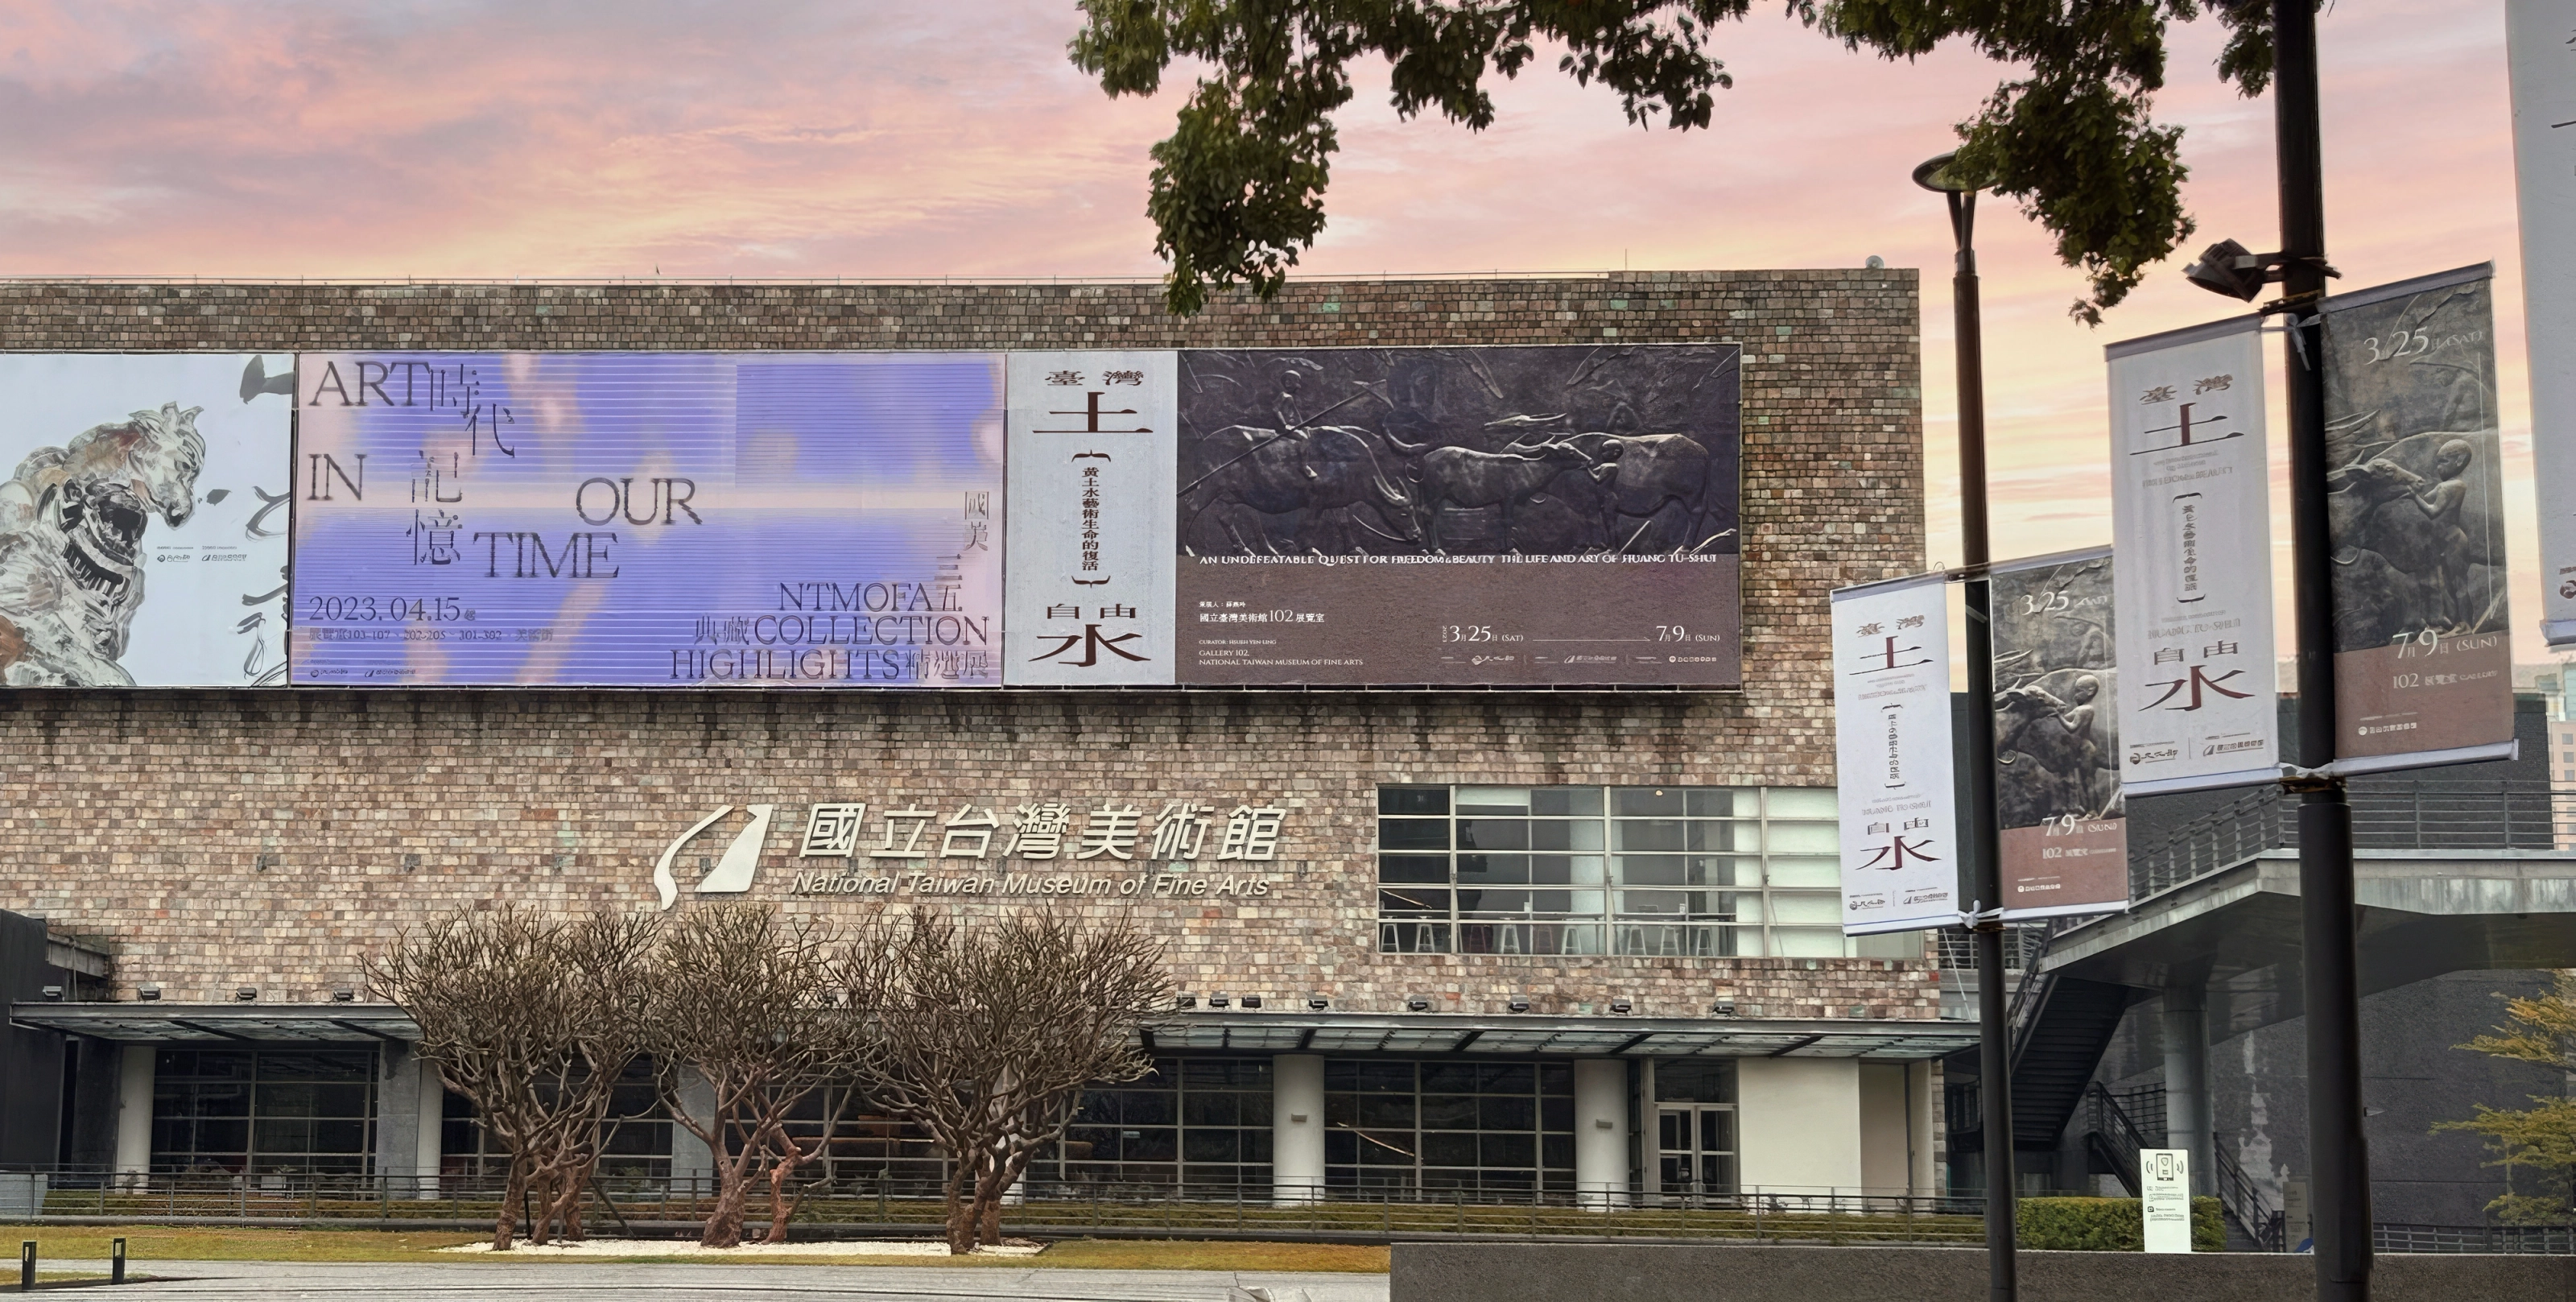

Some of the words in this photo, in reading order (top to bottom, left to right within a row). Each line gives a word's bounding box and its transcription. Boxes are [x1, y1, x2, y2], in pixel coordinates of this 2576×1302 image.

[309, 362, 430, 406] ART
[1045, 370, 1143, 386] 臺灣
[1032, 391, 1154, 433] 土
[2129, 403, 2244, 456] 土
[308, 454, 367, 500] IN
[576, 477, 702, 525] OUR
[473, 532, 619, 577] TIME
[1199, 556, 1217, 564] AN
[779, 582, 933, 612] NTMOFA
[1047, 604, 1136, 619] 自由
[754, 615, 989, 645] COLLECTION
[1028, 624, 1151, 667] 水
[1450, 626, 1498, 642] 3月25日
[1656, 626, 1691, 642] 7月9日
[670, 649, 899, 680] HIGHLIGHTS
[1849, 636, 1934, 675] 土
[2138, 664, 2256, 711] 水
[2393, 673, 2419, 688] 102
[799, 803, 1287, 860] 國立台灣美術館
[1856, 836, 1942, 870] 水
[791, 870, 900, 895] National
[907, 871, 995, 895] Taiwan
[1002, 872, 1111, 895] Museum
[1120, 874, 1149, 895] of
[1152, 874, 1208, 895] Fine
[1216, 874, 1269, 895] Arts
